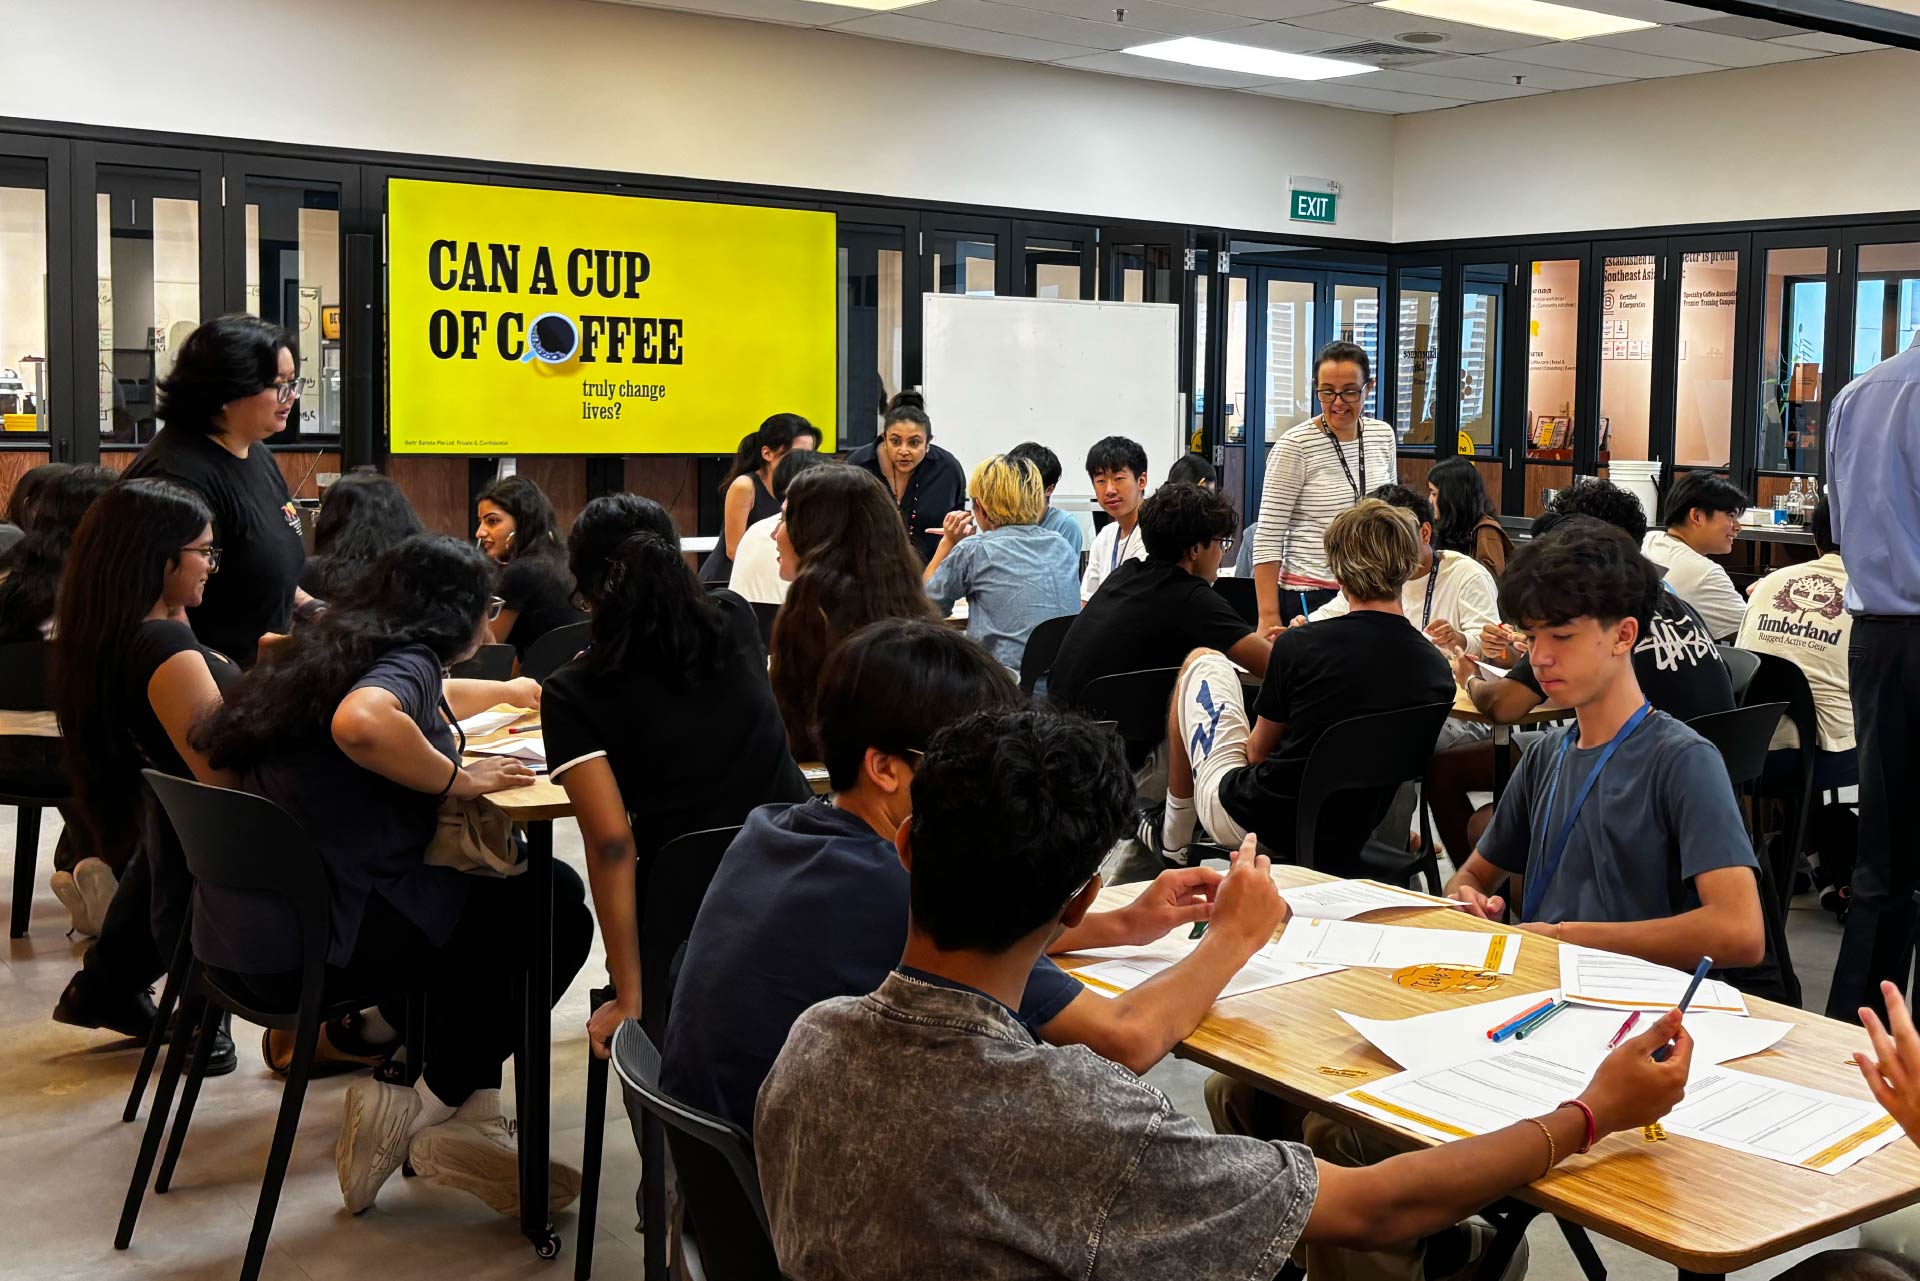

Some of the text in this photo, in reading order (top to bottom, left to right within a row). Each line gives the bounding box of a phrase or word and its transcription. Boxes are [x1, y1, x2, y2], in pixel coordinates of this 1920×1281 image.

[1298, 195, 1329, 218] EXIT
[429, 239, 650, 299] CAN A CUP
[1703, 290, 1716, 298] Coffee
[429, 309, 684, 366] OF COFFEE
[582, 379, 666, 402] truly change
[582, 402, 622, 420] lives?
[1757, 613, 1842, 646] Timberland
[1758, 632, 1827, 652] Rugged Active Gear
